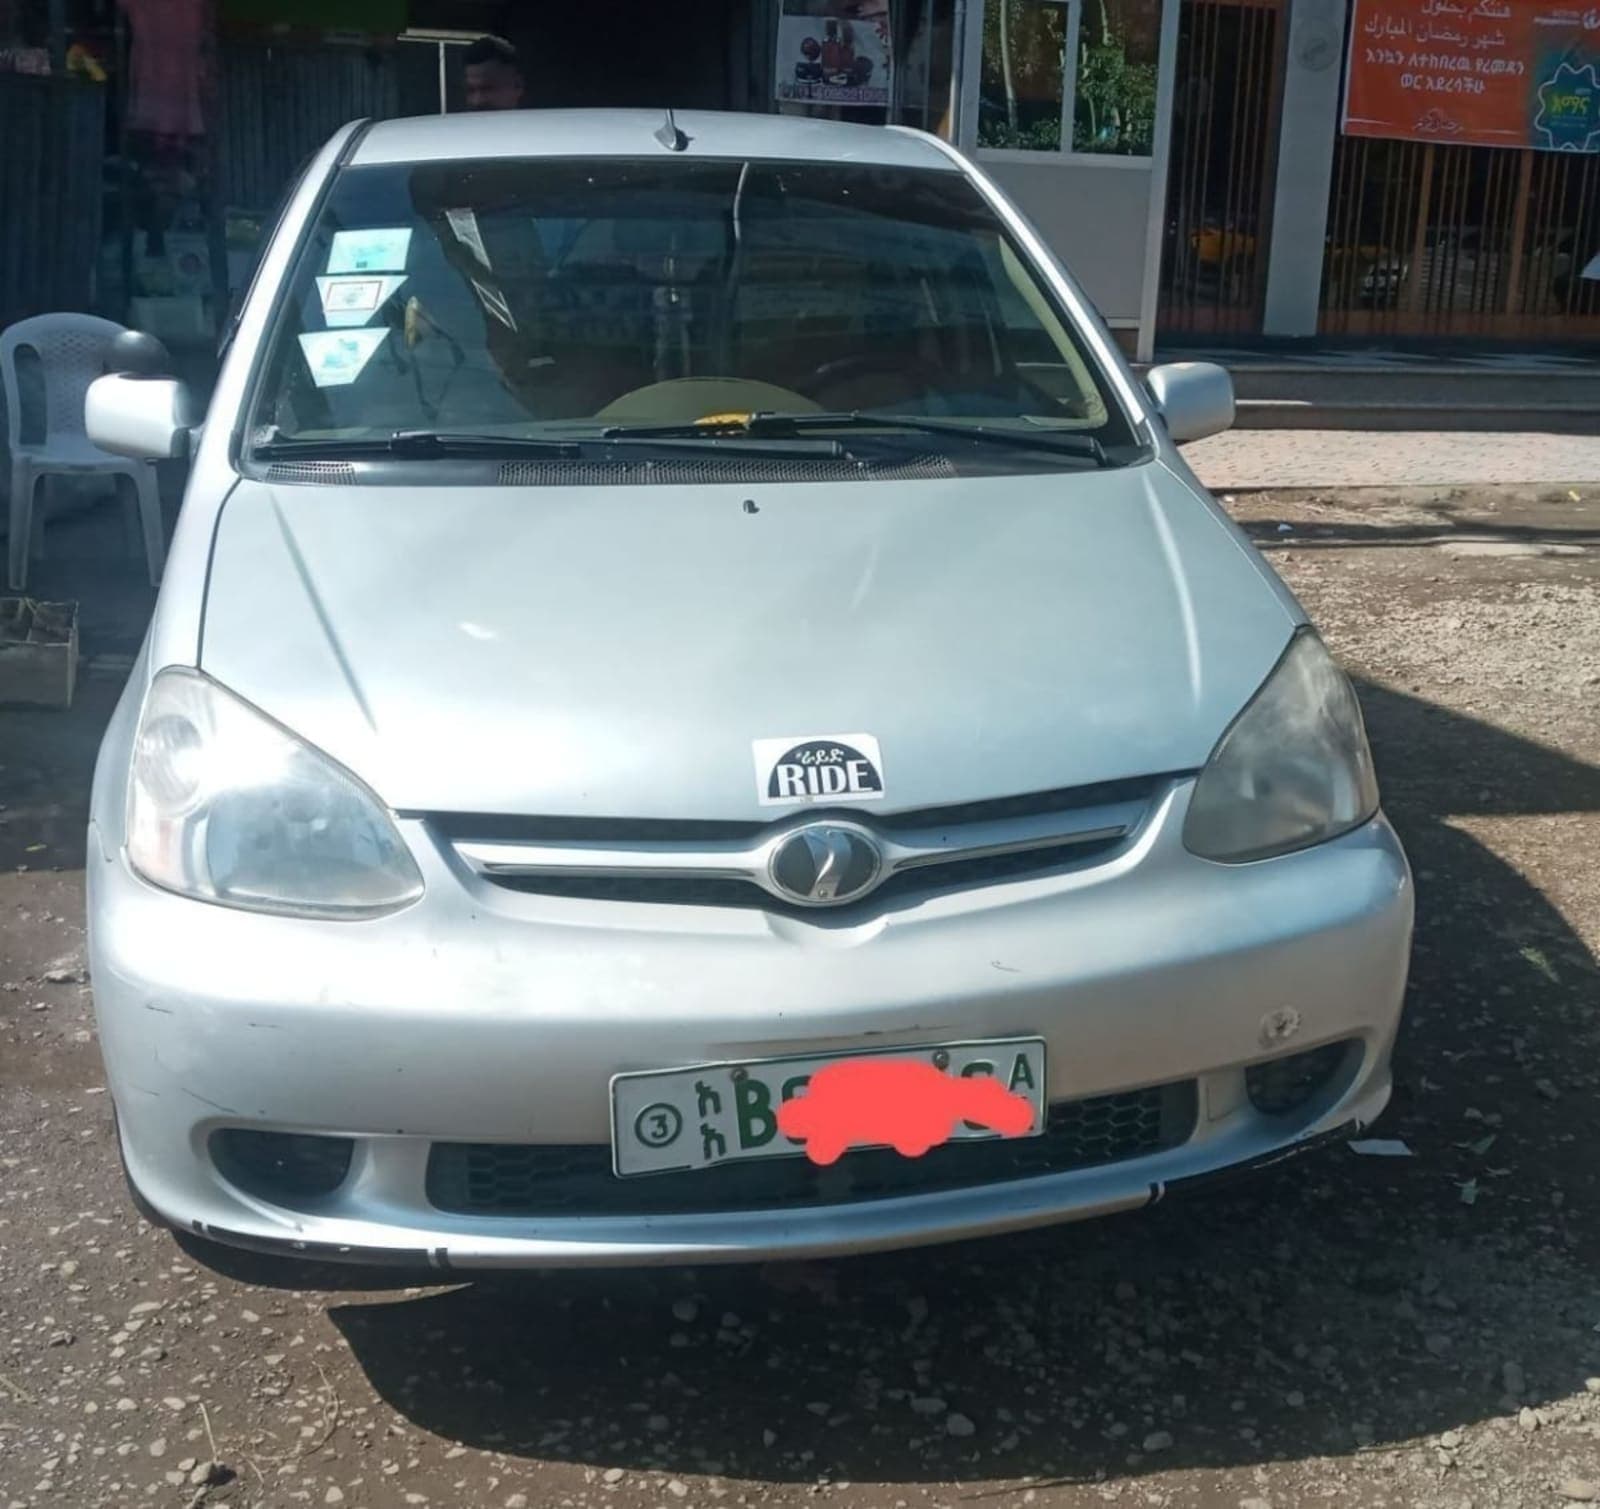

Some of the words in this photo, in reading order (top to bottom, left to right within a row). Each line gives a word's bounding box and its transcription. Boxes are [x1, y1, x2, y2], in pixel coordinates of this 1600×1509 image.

[1365, 13, 1412, 40] المبارك
[1416, 21, 1469, 48] رمضان
[1471, 29, 1505, 49] شهر
[1400, 72, 1423, 90] ወር
[776, 759, 873, 797] RIDE
[649, 1113, 669, 1140] 3
